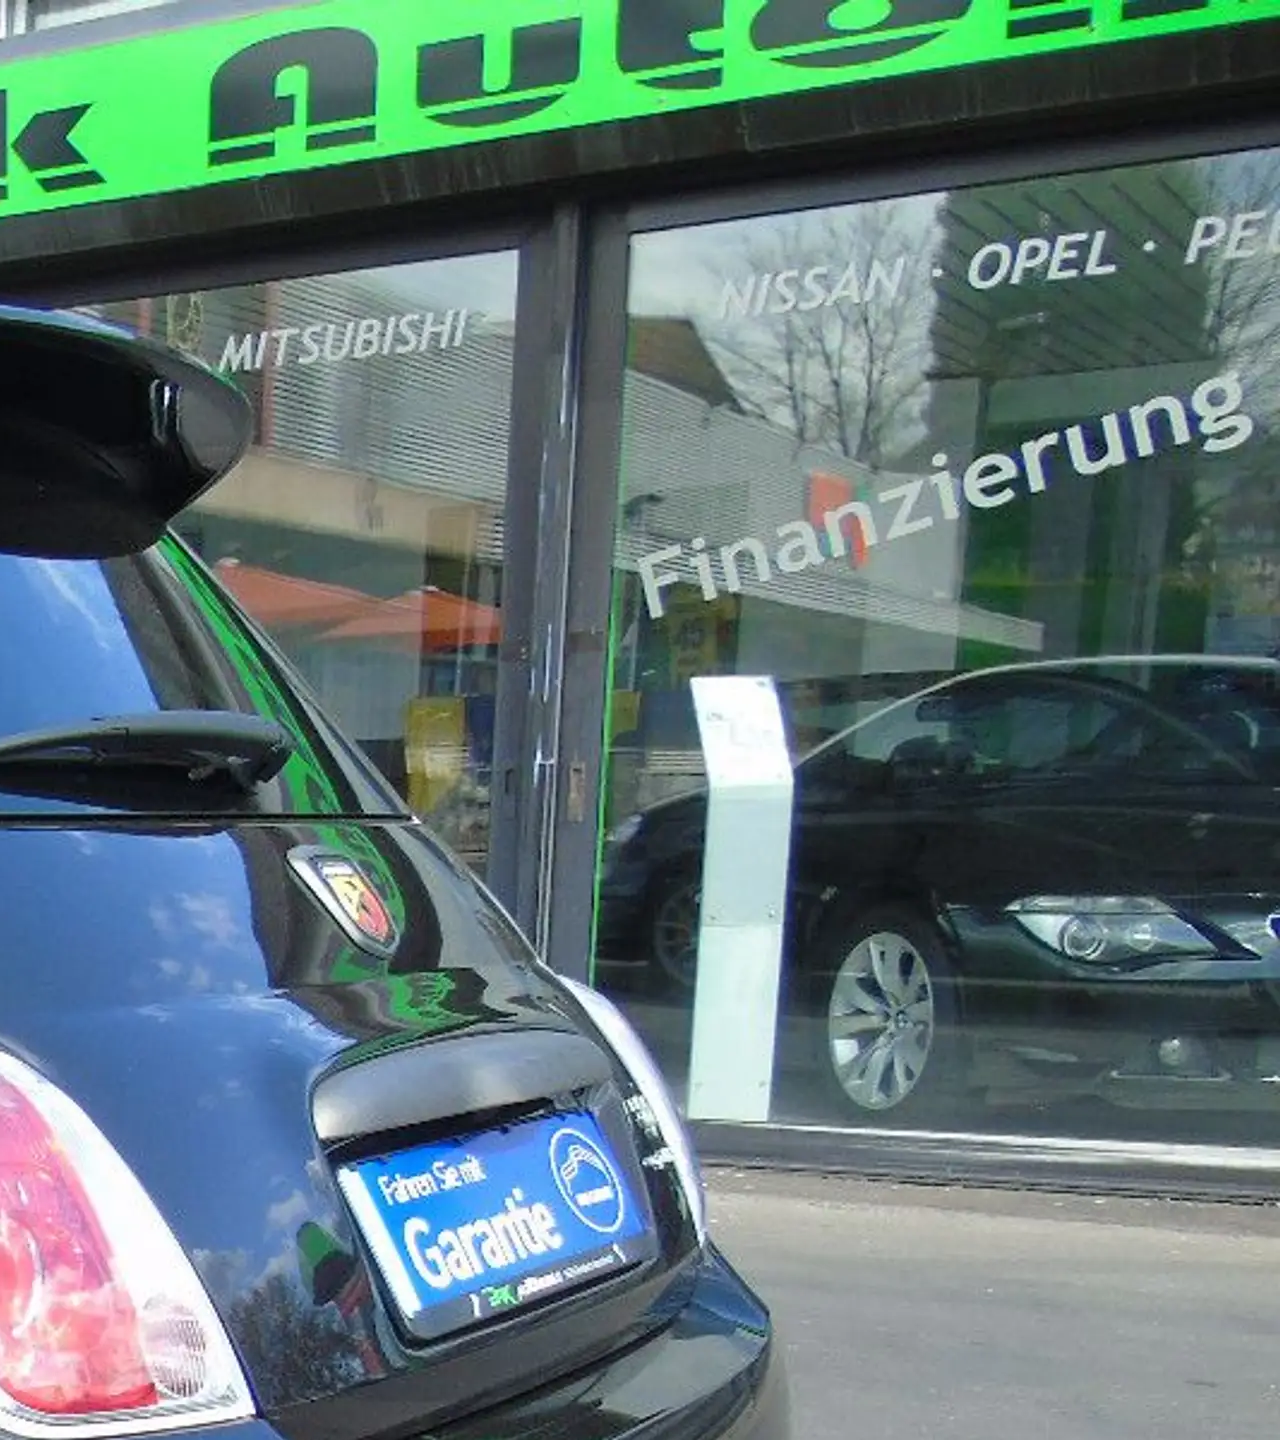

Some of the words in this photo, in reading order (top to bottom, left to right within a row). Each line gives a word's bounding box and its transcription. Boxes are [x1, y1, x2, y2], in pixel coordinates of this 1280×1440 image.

[720, 256, 907, 322] NISSAN
[967, 230, 1117, 290] OPEL
[219, 308, 468, 374] MITSUBISHI
[639, 370, 1253, 620] Finanzierung
[404, 1188, 564, 1288] Garantie
